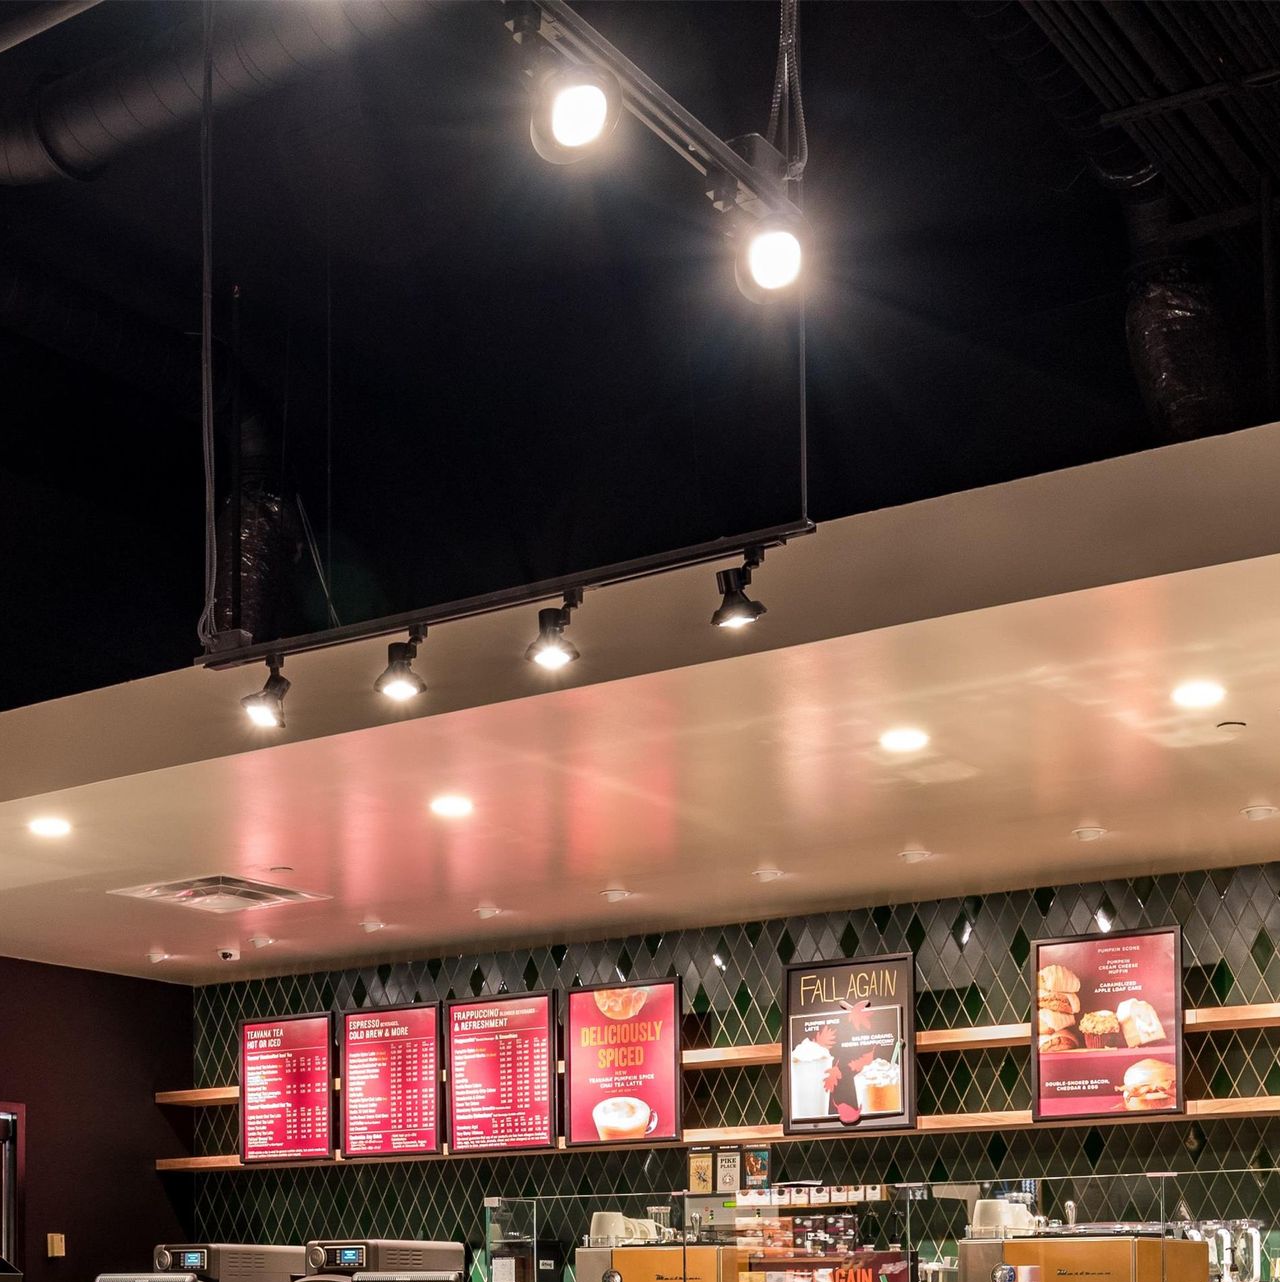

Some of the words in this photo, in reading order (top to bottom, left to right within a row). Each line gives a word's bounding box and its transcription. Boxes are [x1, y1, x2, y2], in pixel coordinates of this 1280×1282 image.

[800, 975, 845, 1006] FALL
[846, 969, 897, 1000] AGAIN
[349, 1019, 380, 1030] ESPRESSO
[454, 1022, 460, 1032] &
[460, 1018, 508, 1031] REFRESHMENT
[273, 1028, 284, 1037] TEA
[349, 1031, 364, 1040] COLD
[365, 1029, 384, 1039] BREW
[384, 1028, 390, 1037] &
[391, 1026, 409, 1037] MORE
[581, 1020, 663, 1048] DELICIOUSLY
[247, 1040, 258, 1049] HOT
[259, 1039, 267, 1048] OR
[268, 1038, 281, 1048] ICED
[598, 1046, 644, 1069] SPICED
